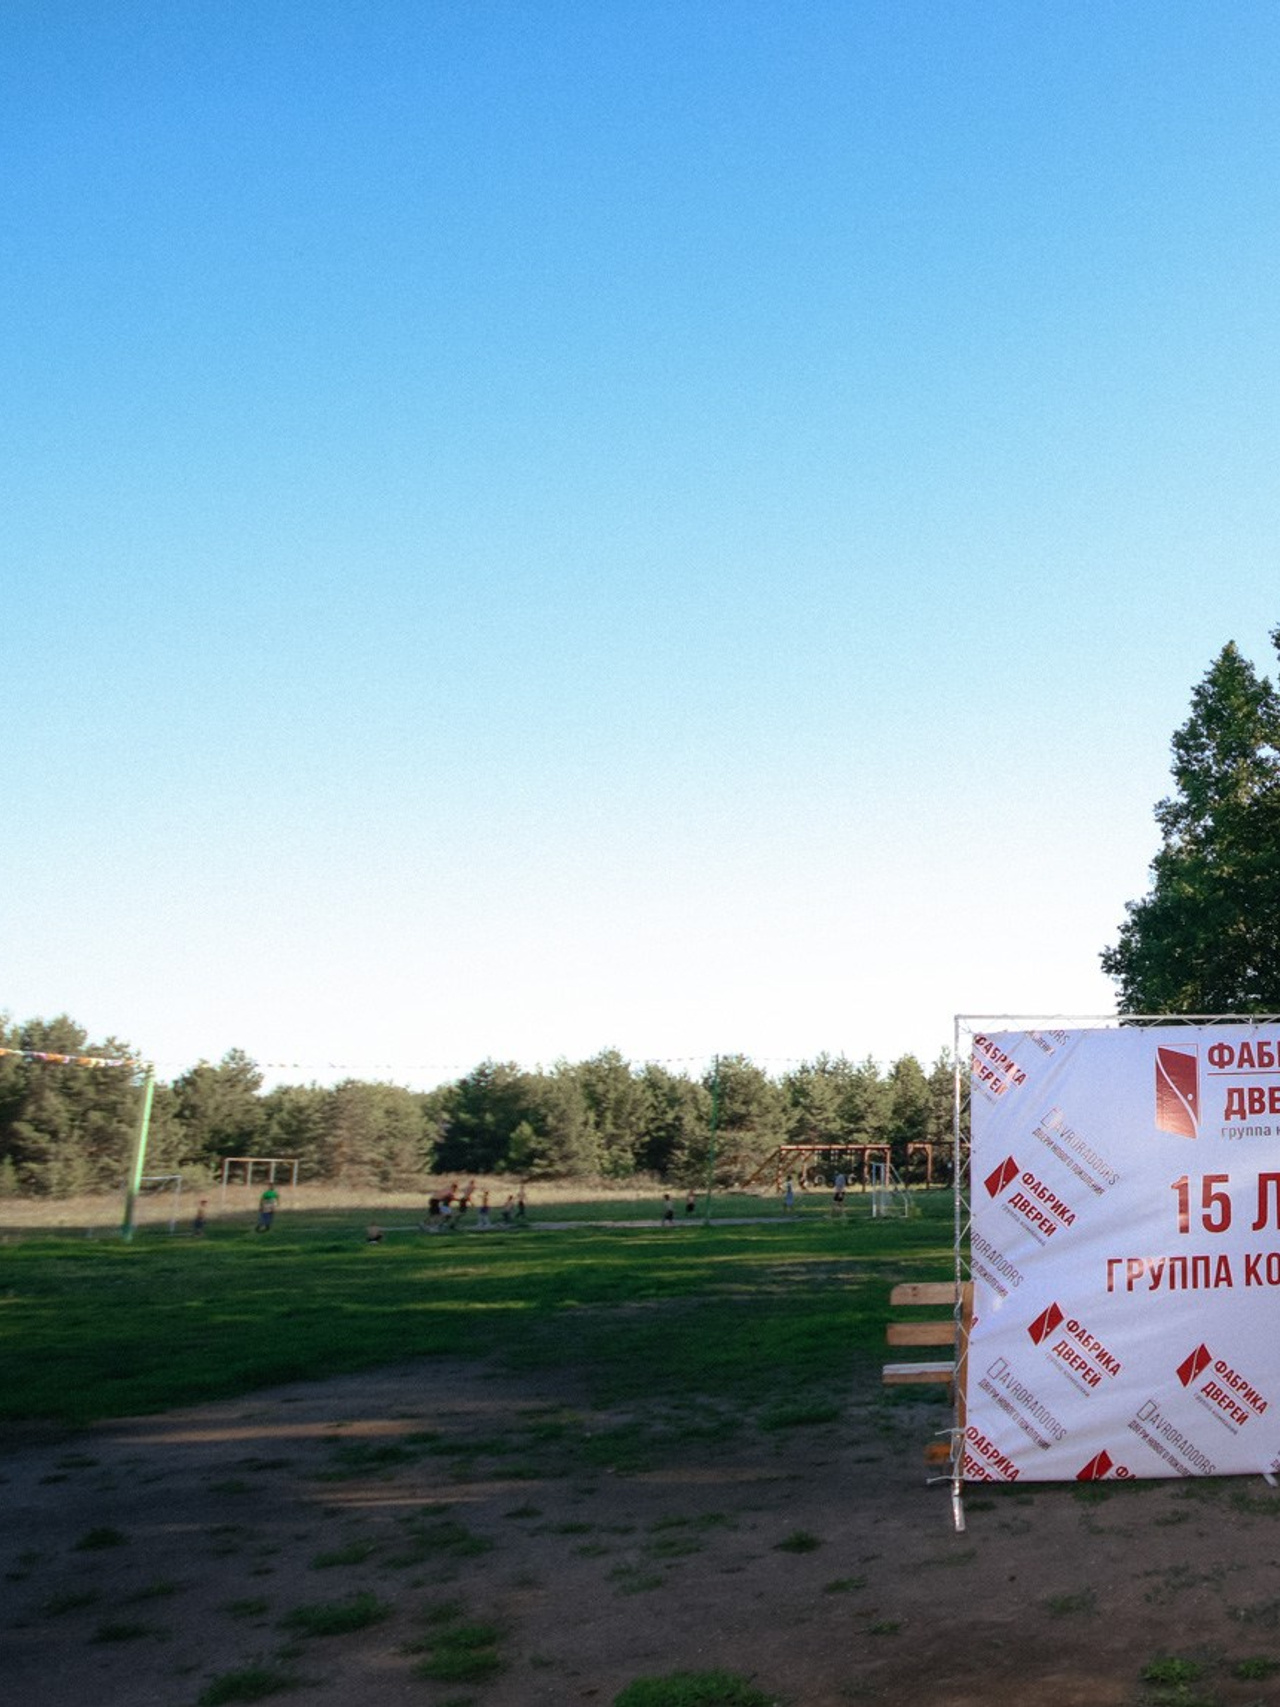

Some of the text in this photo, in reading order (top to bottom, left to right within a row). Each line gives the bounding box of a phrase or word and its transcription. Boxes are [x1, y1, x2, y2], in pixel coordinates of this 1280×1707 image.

[1221, 1124, 1271, 1139] группа
[1007, 1192, 1057, 1237] ДВЕРЕЙ
[1022, 1172, 1075, 1226] ФАБРИКА
[1170, 1173, 1231, 1234] 15
[1107, 1255, 1233, 1292] ГРУППА
[1052, 1340, 1102, 1388] ДВЕРЕЙ
[1066, 1319, 1121, 1377] ФАБРИКА
[998, 1372, 1067, 1441] AVRORADOORS
[1200, 1381, 1249, 1426] ДВЕРЕЙ
[1214, 1360, 1268, 1414] ФАБРИКА
[966, 1426, 1020, 1482] ФАБРИКА
[1149, 1413, 1216, 1475] AVRORADOORS
